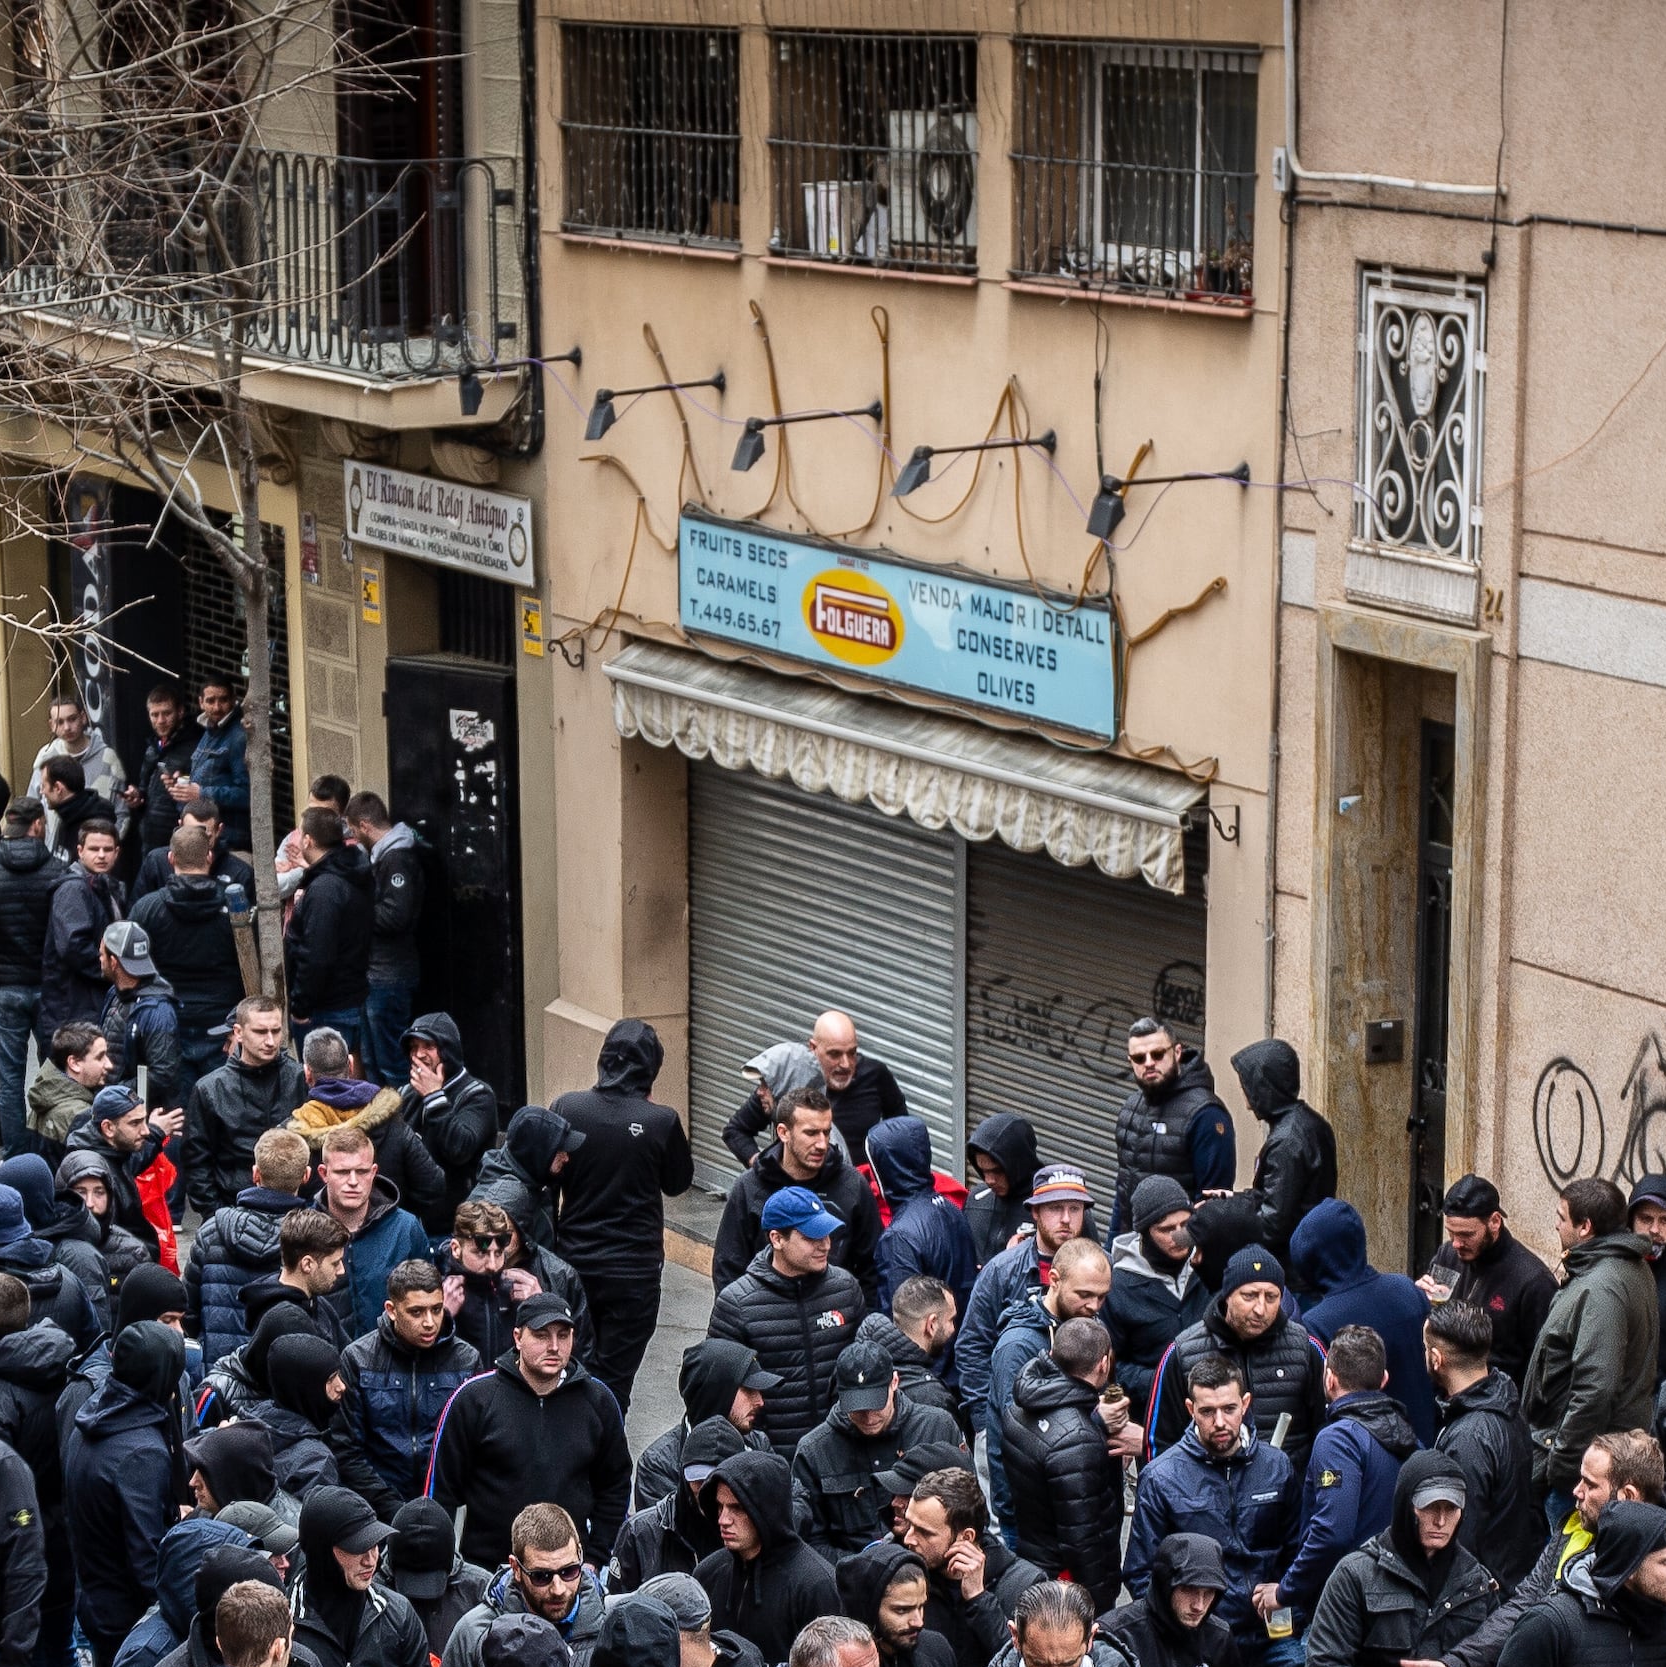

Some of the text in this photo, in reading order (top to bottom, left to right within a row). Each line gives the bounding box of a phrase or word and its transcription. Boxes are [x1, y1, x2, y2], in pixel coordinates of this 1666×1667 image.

[366, 470, 508, 539] El Rincón del Reloj Antiguo
[365, 525, 509, 571] RELOJES DE MARCA Y PEQUEÑAS ANTIGÜEDADES
[419, 523, 429, 535] DE
[449, 530, 481, 549] ANTIGUAS
[482, 537, 487, 548] Y
[488, 538, 504, 554] ORO
[689, 529, 788, 568] FRUITS SECS
[696, 567, 777, 604] CARAMELS
[689, 598, 781, 639] T.449.65.67
[815, 582, 891, 647] FOLGUERA
[908, 580, 1105, 644] VENDA MAJOR I DETALL
[956, 628, 1058, 671] CONSERVES
[977, 671, 1035, 705] OLIVES
